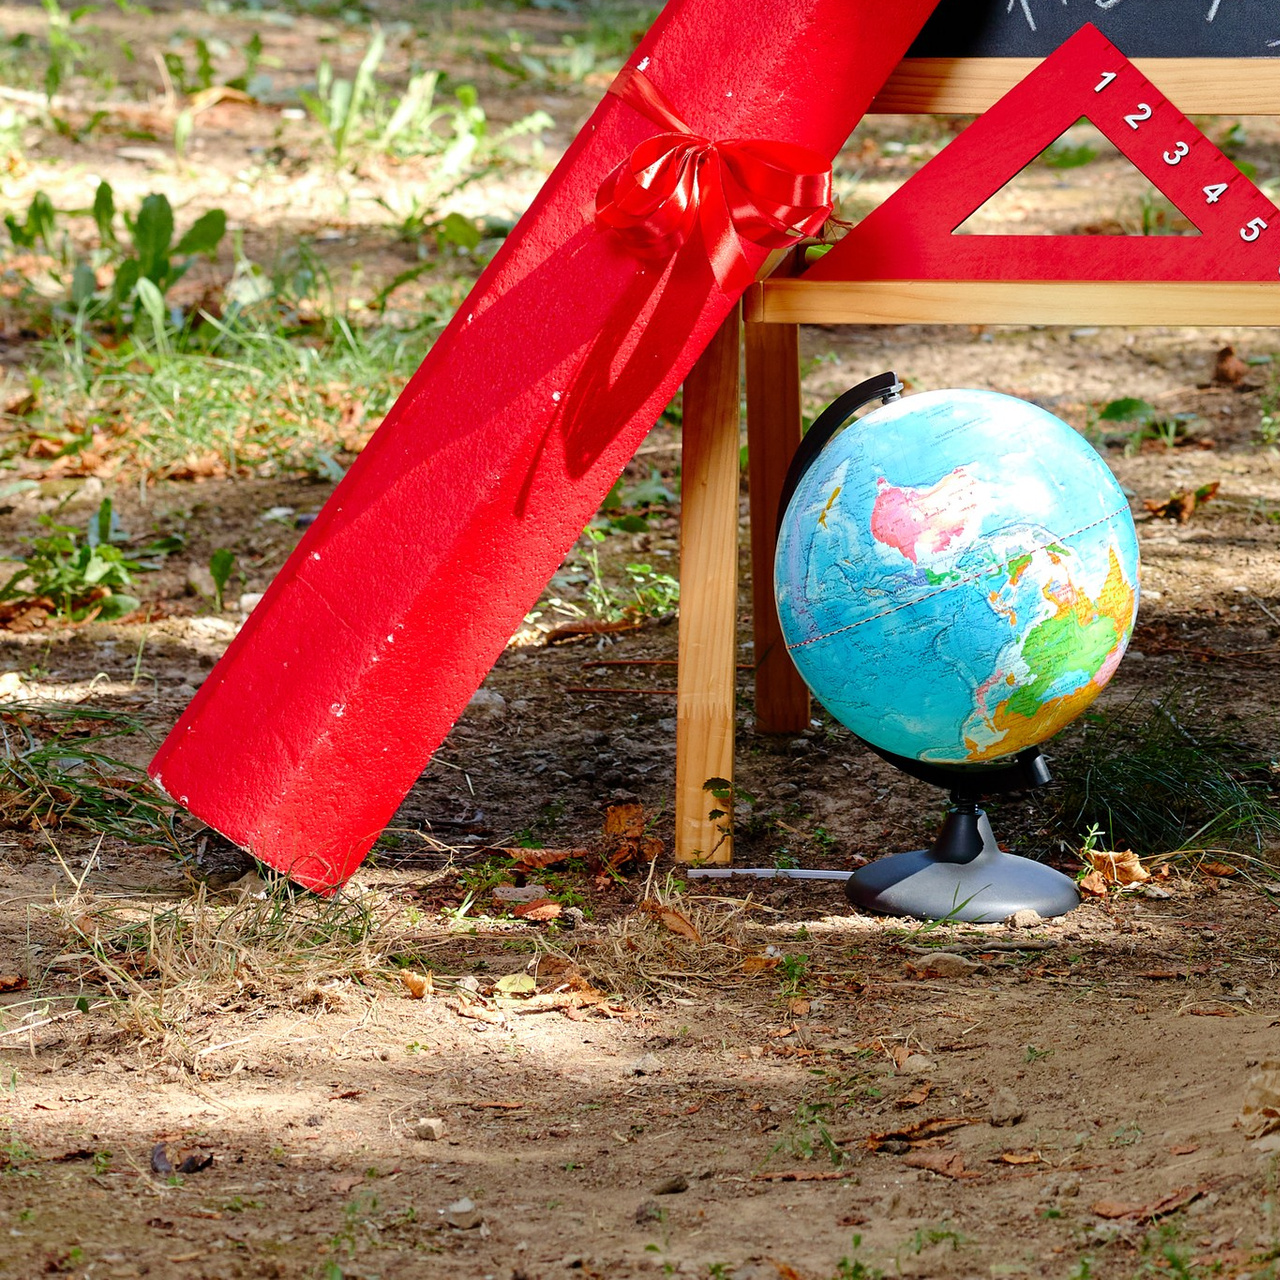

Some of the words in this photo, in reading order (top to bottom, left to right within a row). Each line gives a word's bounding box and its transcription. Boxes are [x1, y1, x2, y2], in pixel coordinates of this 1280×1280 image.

[1095, 71, 1118, 93] 1
[1123, 103, 1152, 130] 2
[1163, 140, 1190, 166] 3
[1202, 181, 1230, 205] 4
[1239, 216, 1268, 243] 5
